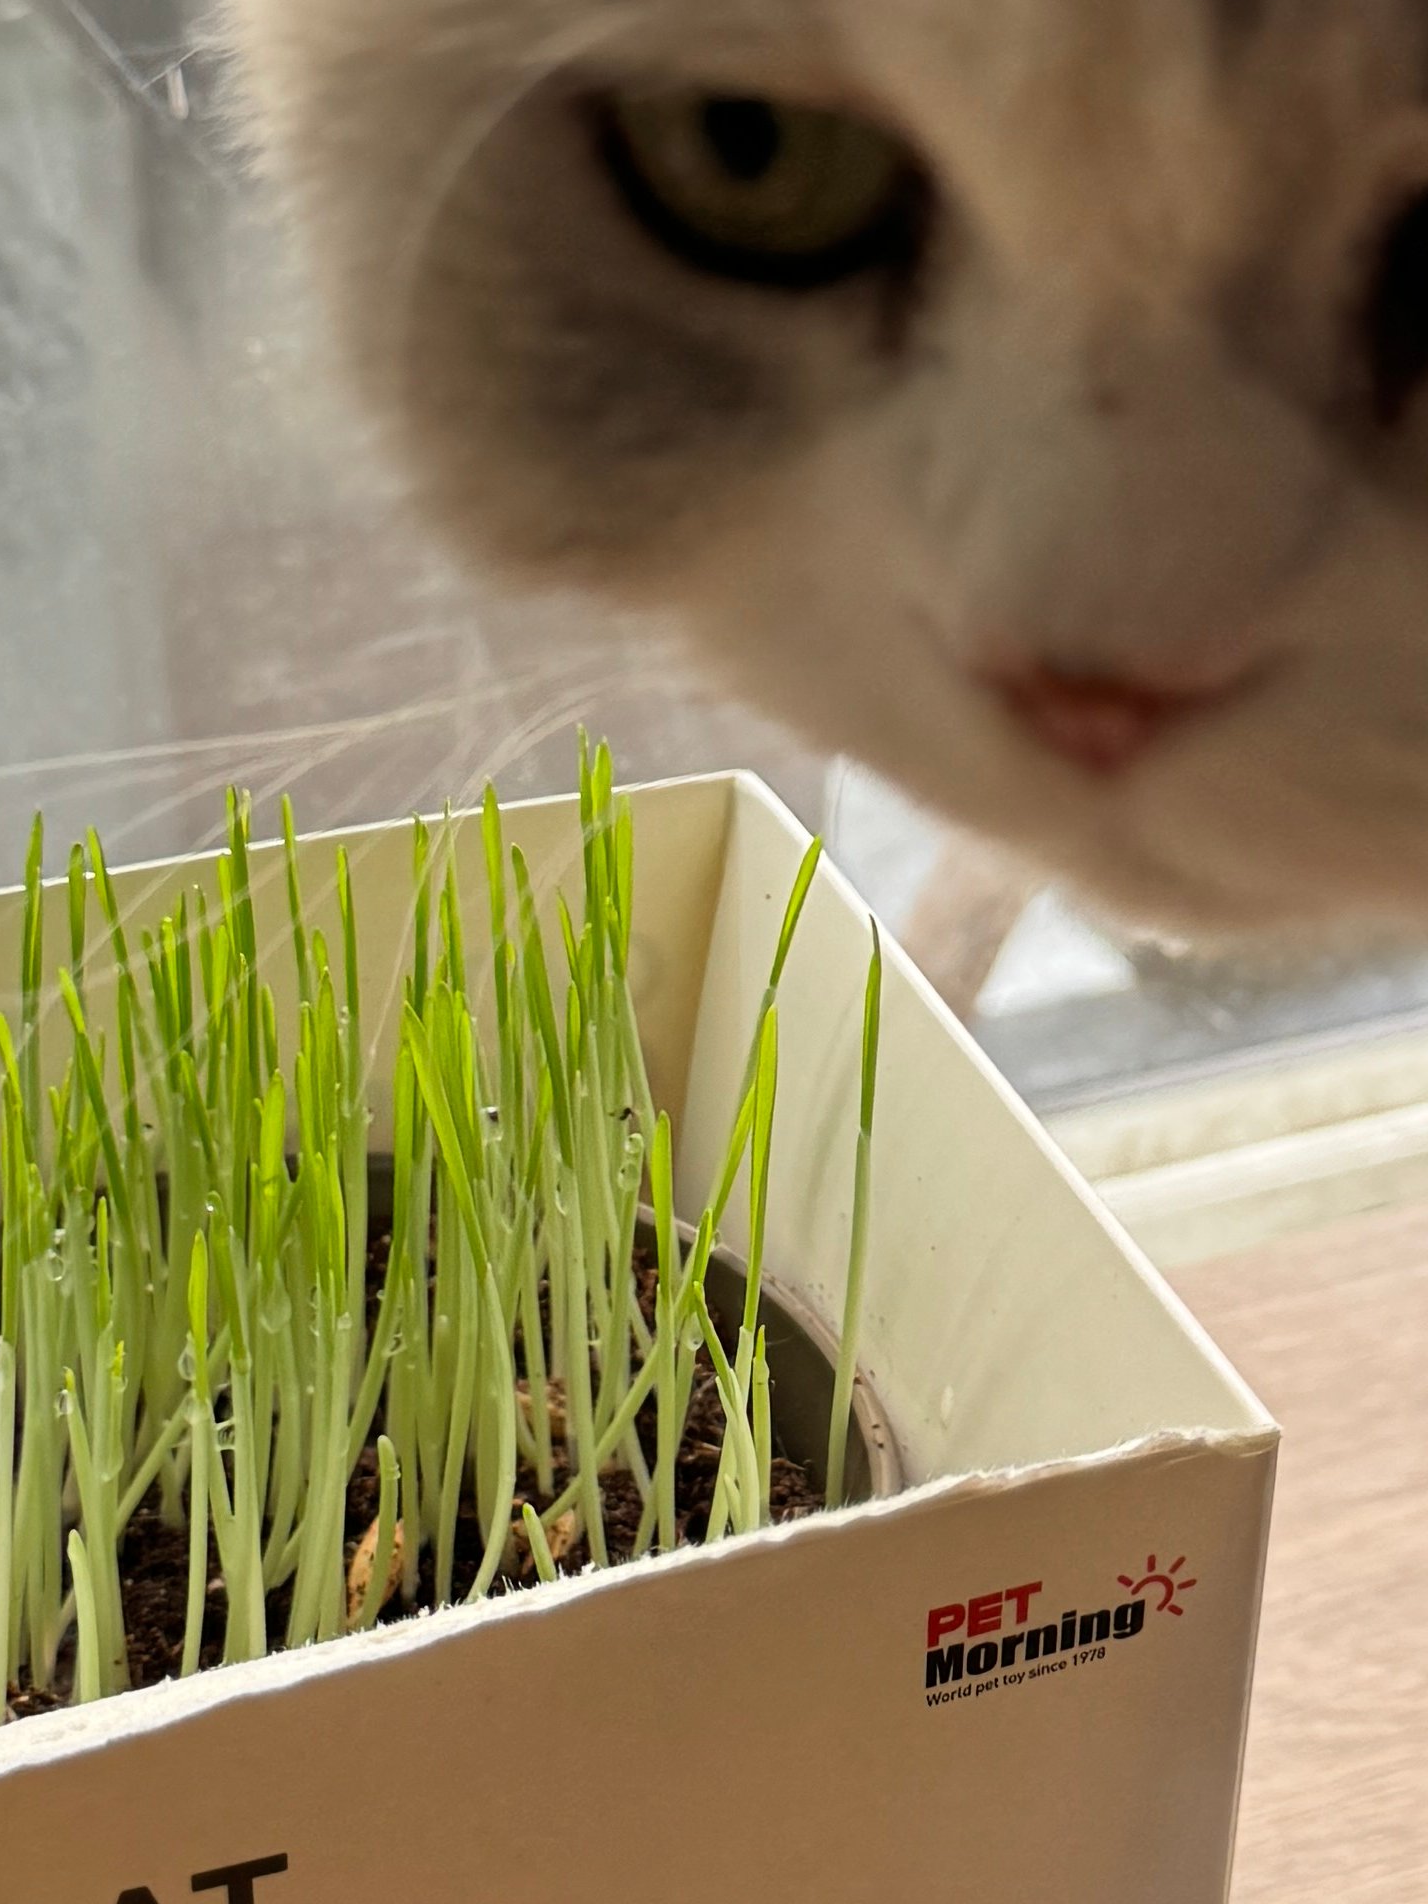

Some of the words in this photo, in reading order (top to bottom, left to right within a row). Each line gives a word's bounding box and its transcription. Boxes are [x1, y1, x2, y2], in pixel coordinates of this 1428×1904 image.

[925, 1598, 1146, 1688] Morning
[926, 1580, 1043, 1648] PET
[925, 1683, 972, 1707] World
[975, 1677, 999, 1696] pet
[1003, 1670, 1026, 1686] toy
[1028, 1659, 1067, 1679] since
[1072, 1647, 1106, 1667] 1978
